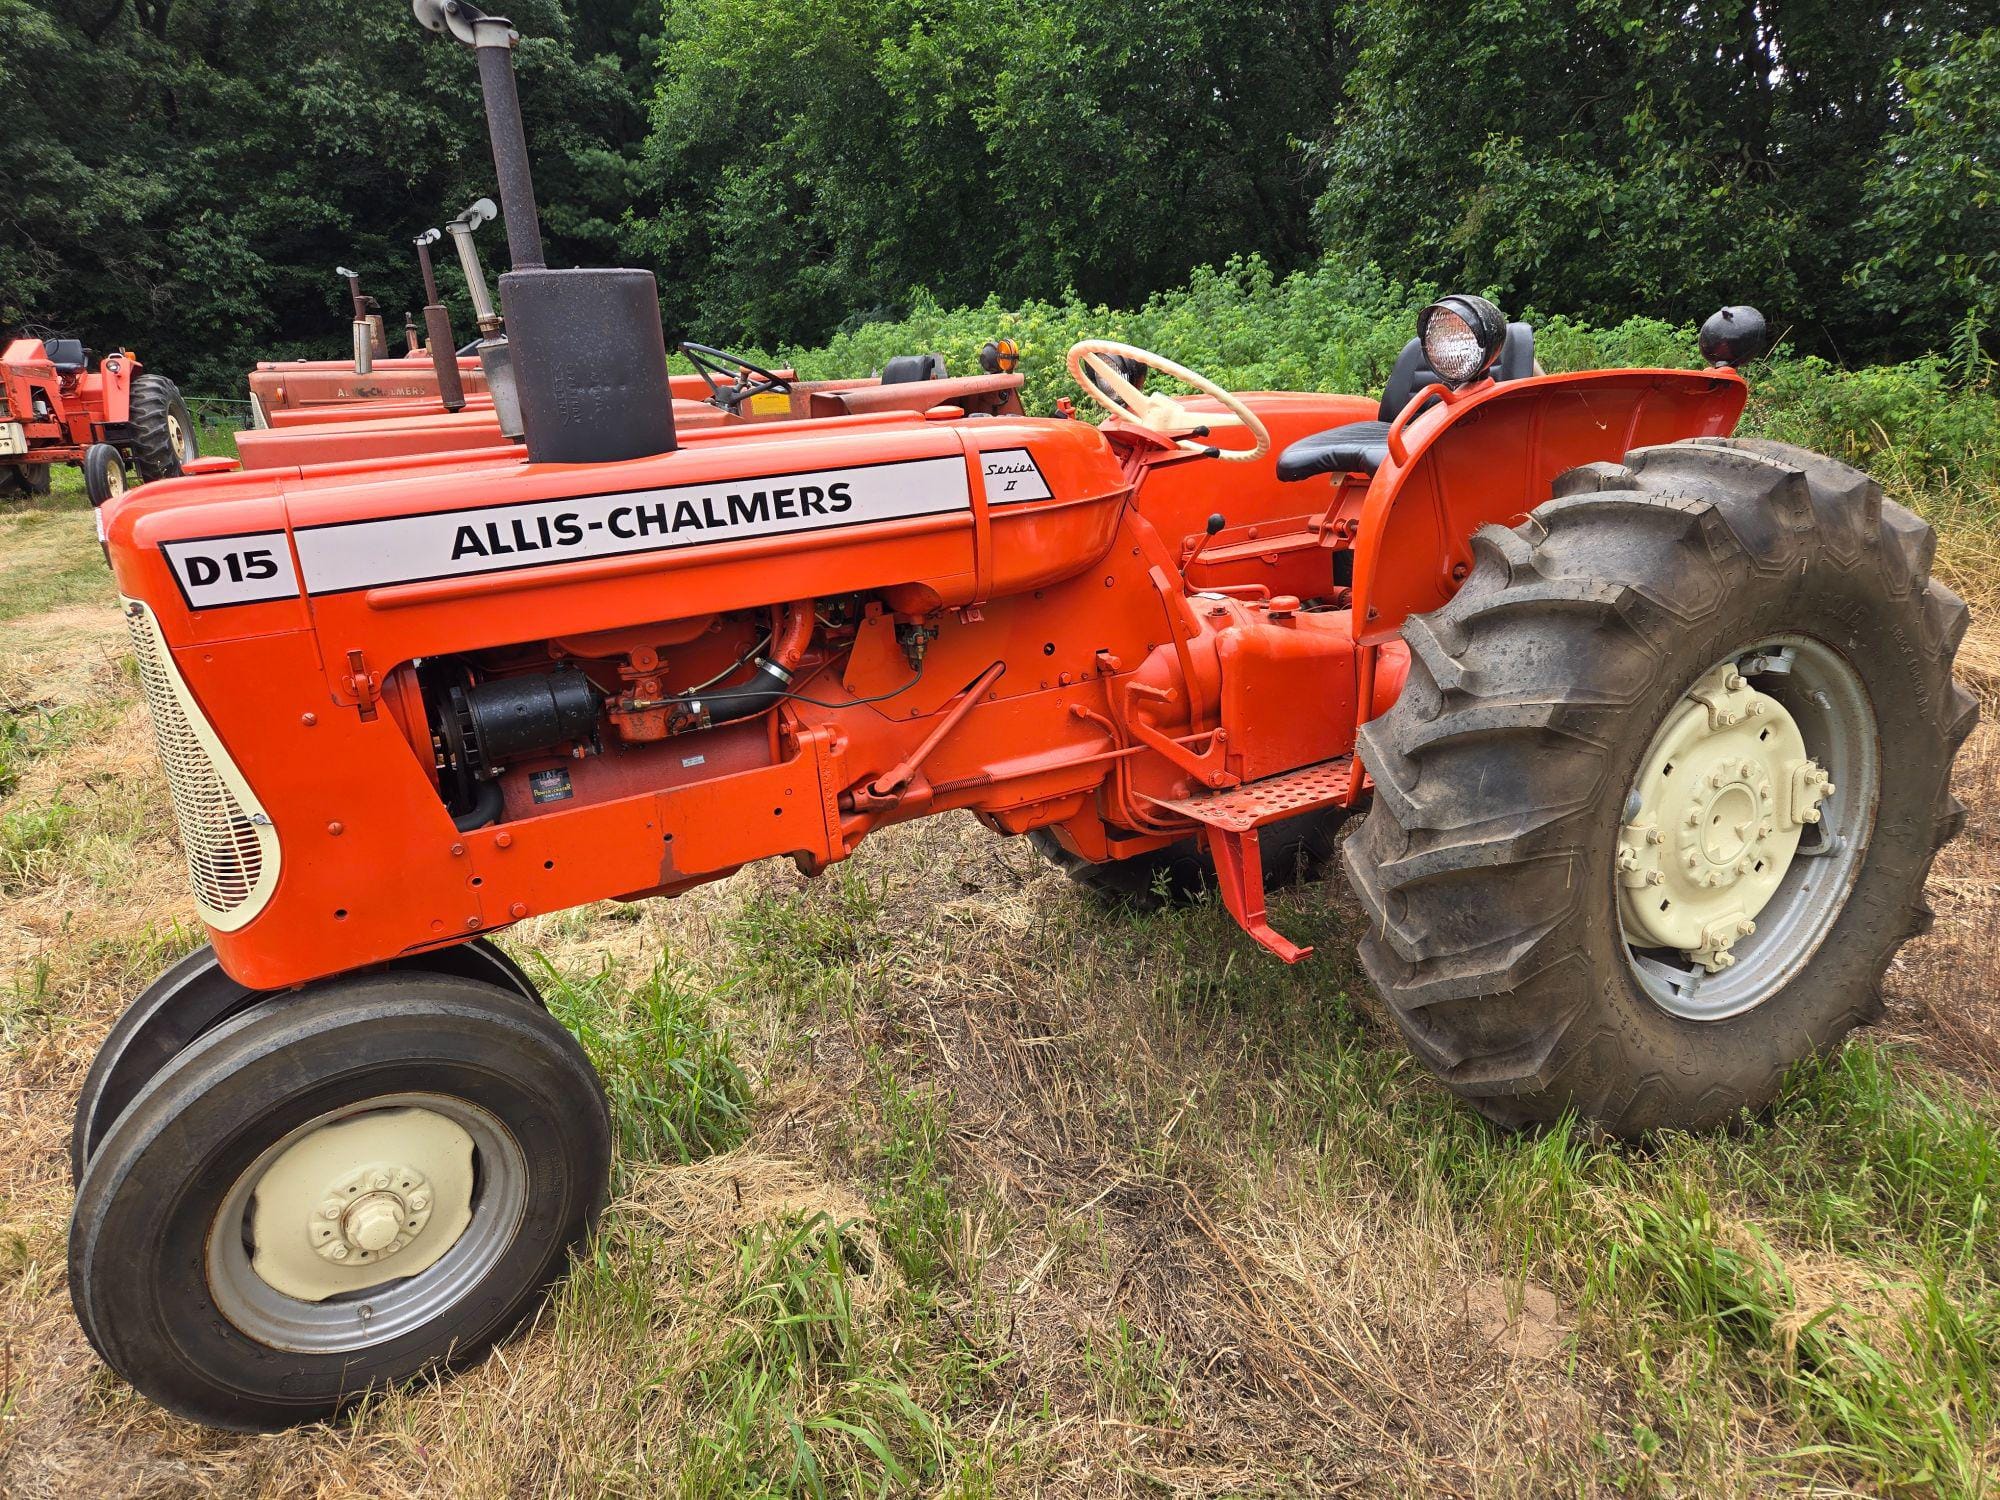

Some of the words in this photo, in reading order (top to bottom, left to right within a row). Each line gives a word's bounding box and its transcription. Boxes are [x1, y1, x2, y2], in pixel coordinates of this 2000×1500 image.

[984, 463, 1035, 476] Series
[1003, 480, 1018, 491] II
[451, 482, 853, 560] ALLIS-CHALMERS
[184, 549, 279, 586] D15
